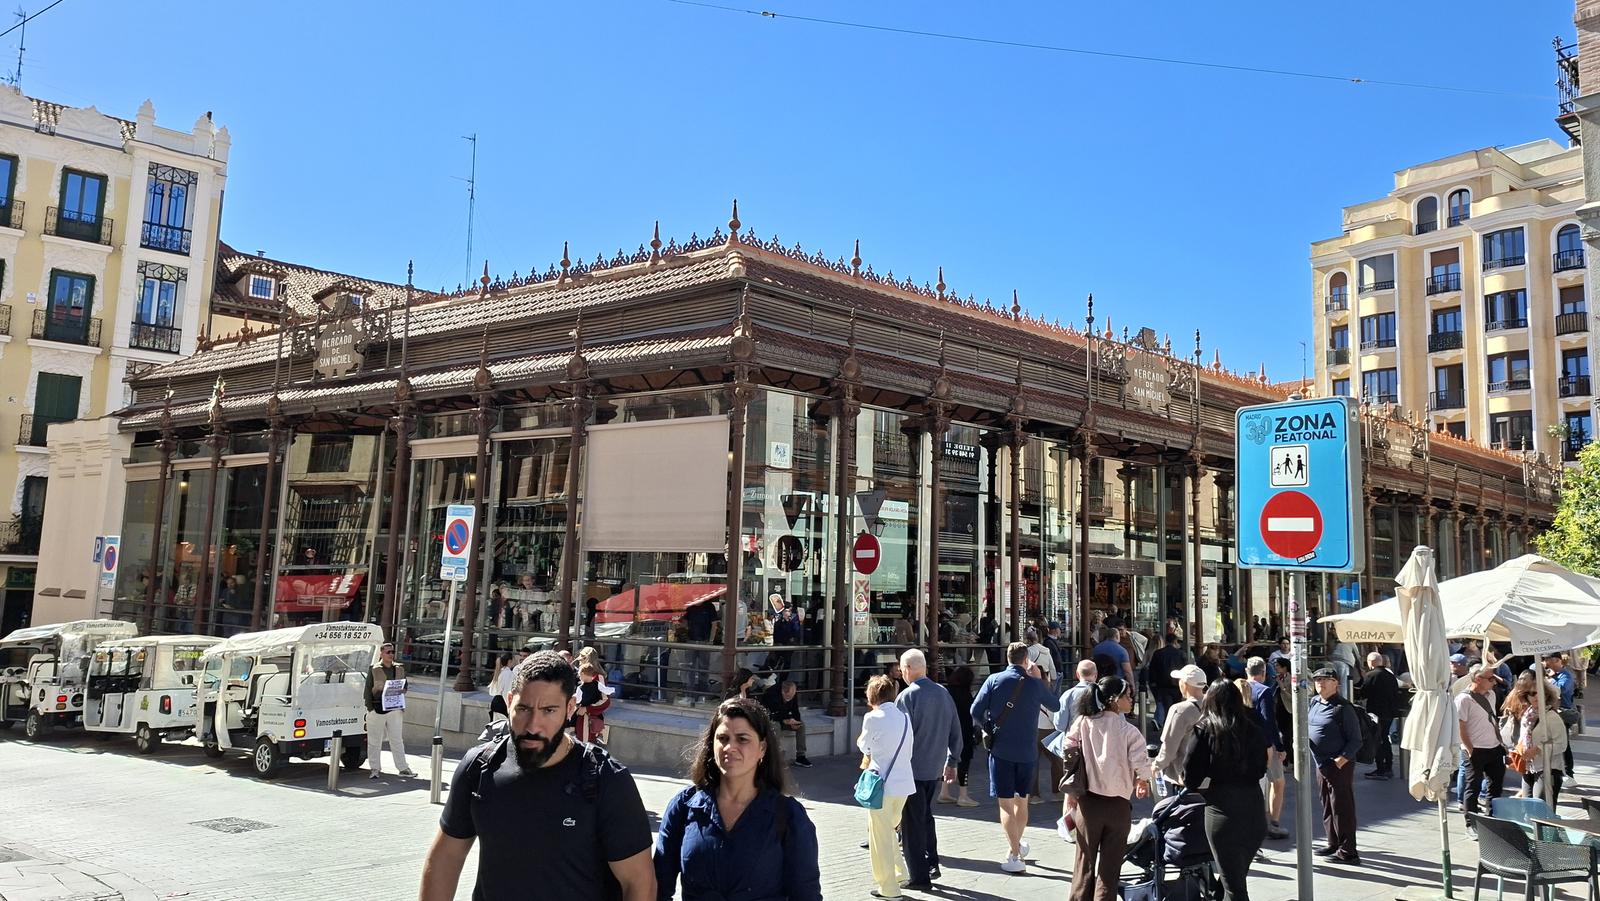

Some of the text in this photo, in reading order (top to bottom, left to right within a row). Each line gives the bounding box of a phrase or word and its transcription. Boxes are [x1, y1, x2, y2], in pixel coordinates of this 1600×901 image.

[322, 335, 352, 348] MERCADO
[319, 354, 352, 368] SAN MIGUEL
[1133, 368, 1164, 383] MERCADO
[1133, 386, 1166, 402] SAN MIGUEL
[1245, 413, 1262, 421] MADRID
[1274, 412, 1336, 433] ZONA
[1274, 430, 1337, 443] PEATONAL
[325, 624, 367, 632] Vamostuktour.com
[315, 717, 358, 727] Vamostuktour.com
